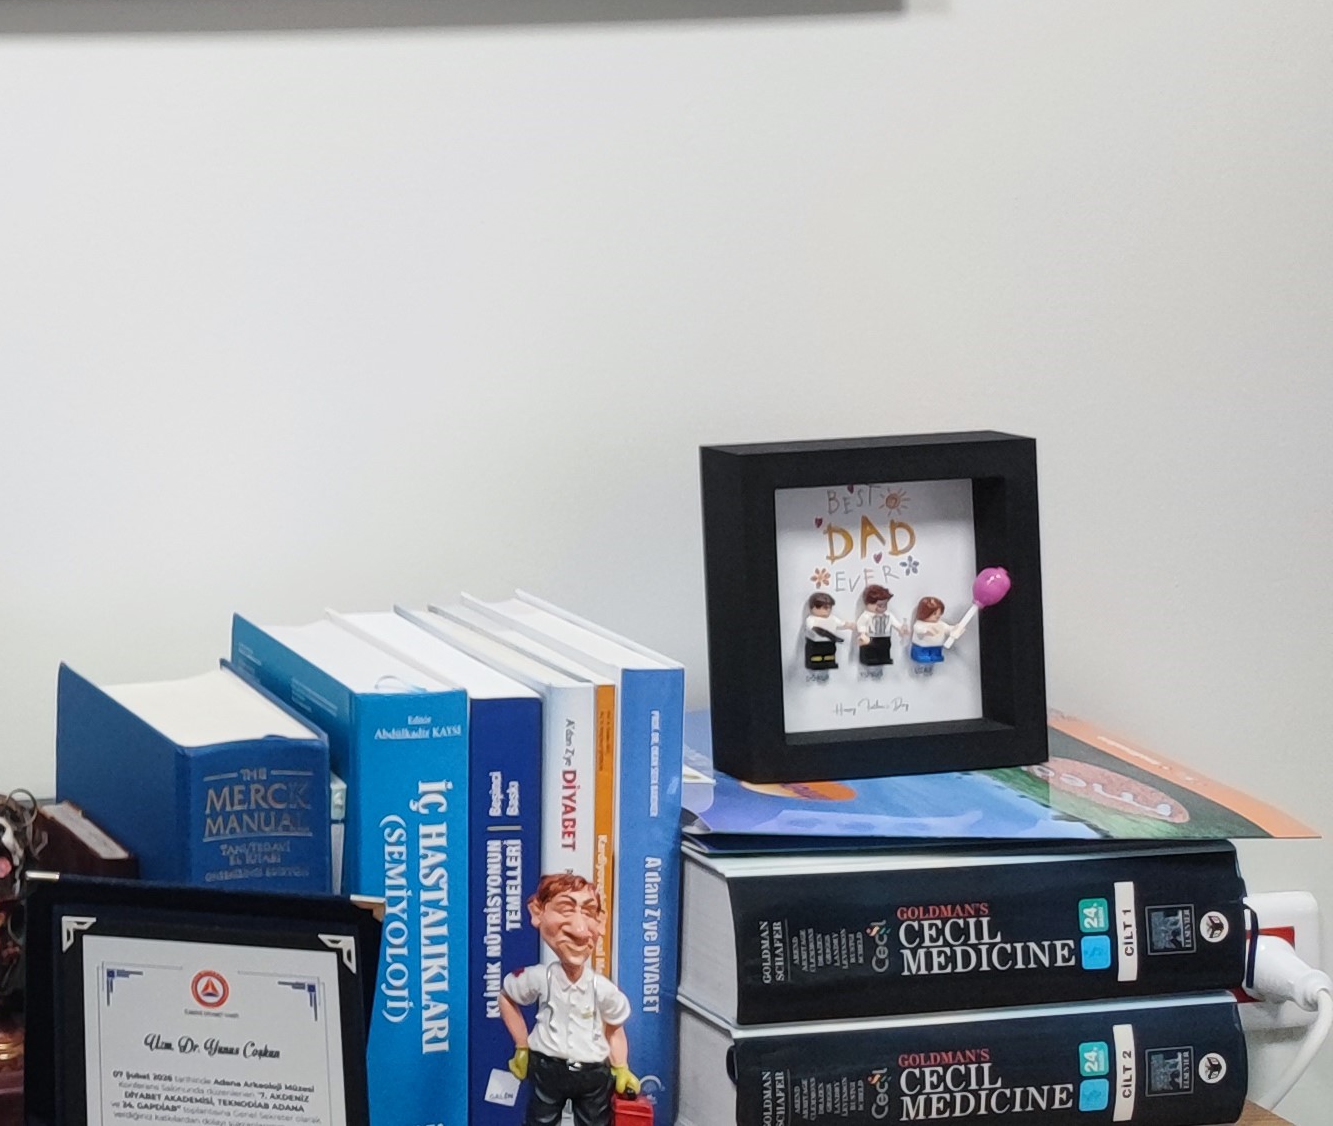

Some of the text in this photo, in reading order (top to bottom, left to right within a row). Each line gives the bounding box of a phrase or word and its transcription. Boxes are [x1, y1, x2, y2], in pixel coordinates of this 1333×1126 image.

[826, 485, 881, 514] BEST
[822, 515, 916, 564] DAD
[835, 565, 900, 592] EVER
[239, 767, 267, 781] THE
[205, 781, 312, 815] MERCK
[562, 770, 581, 851] DİYABET
[204, 810, 310, 838] MANUAL
[503, 839, 523, 931] TEMELLERİ
[379, 813, 415, 1024] (SEMİYOLOJİ)
[409, 779, 454, 1055] İÇ HASTALIKLARI
[483, 839, 502, 1018] KLİNİK NÜTRİSYONUN
[896, 903, 989, 920] GOLDMAN'S
[898, 917, 1001, 948] CECIL
[1122, 908, 1134, 957] CİLT 1
[759, 921, 772, 984] GOLDMAN
[772, 921, 785, 981] SCHAFER
[899, 940, 1076, 976] MEDICINE
[204, 1037, 239, 1057] Yunus
[898, 1048, 990, 1067] GOLDMAN'S
[213, 1078, 241, 1087] Adana
[899, 1062, 1002, 1095] CECIL
[1121, 1050, 1132, 1099] CİLT 2
[124, 1090, 161, 1101] DİYABET
[272, 1103, 305, 1112] ADANA
[269, 1093, 309, 1103] AKDENİZ
[899, 1083, 1074, 1122] MEDICINE
